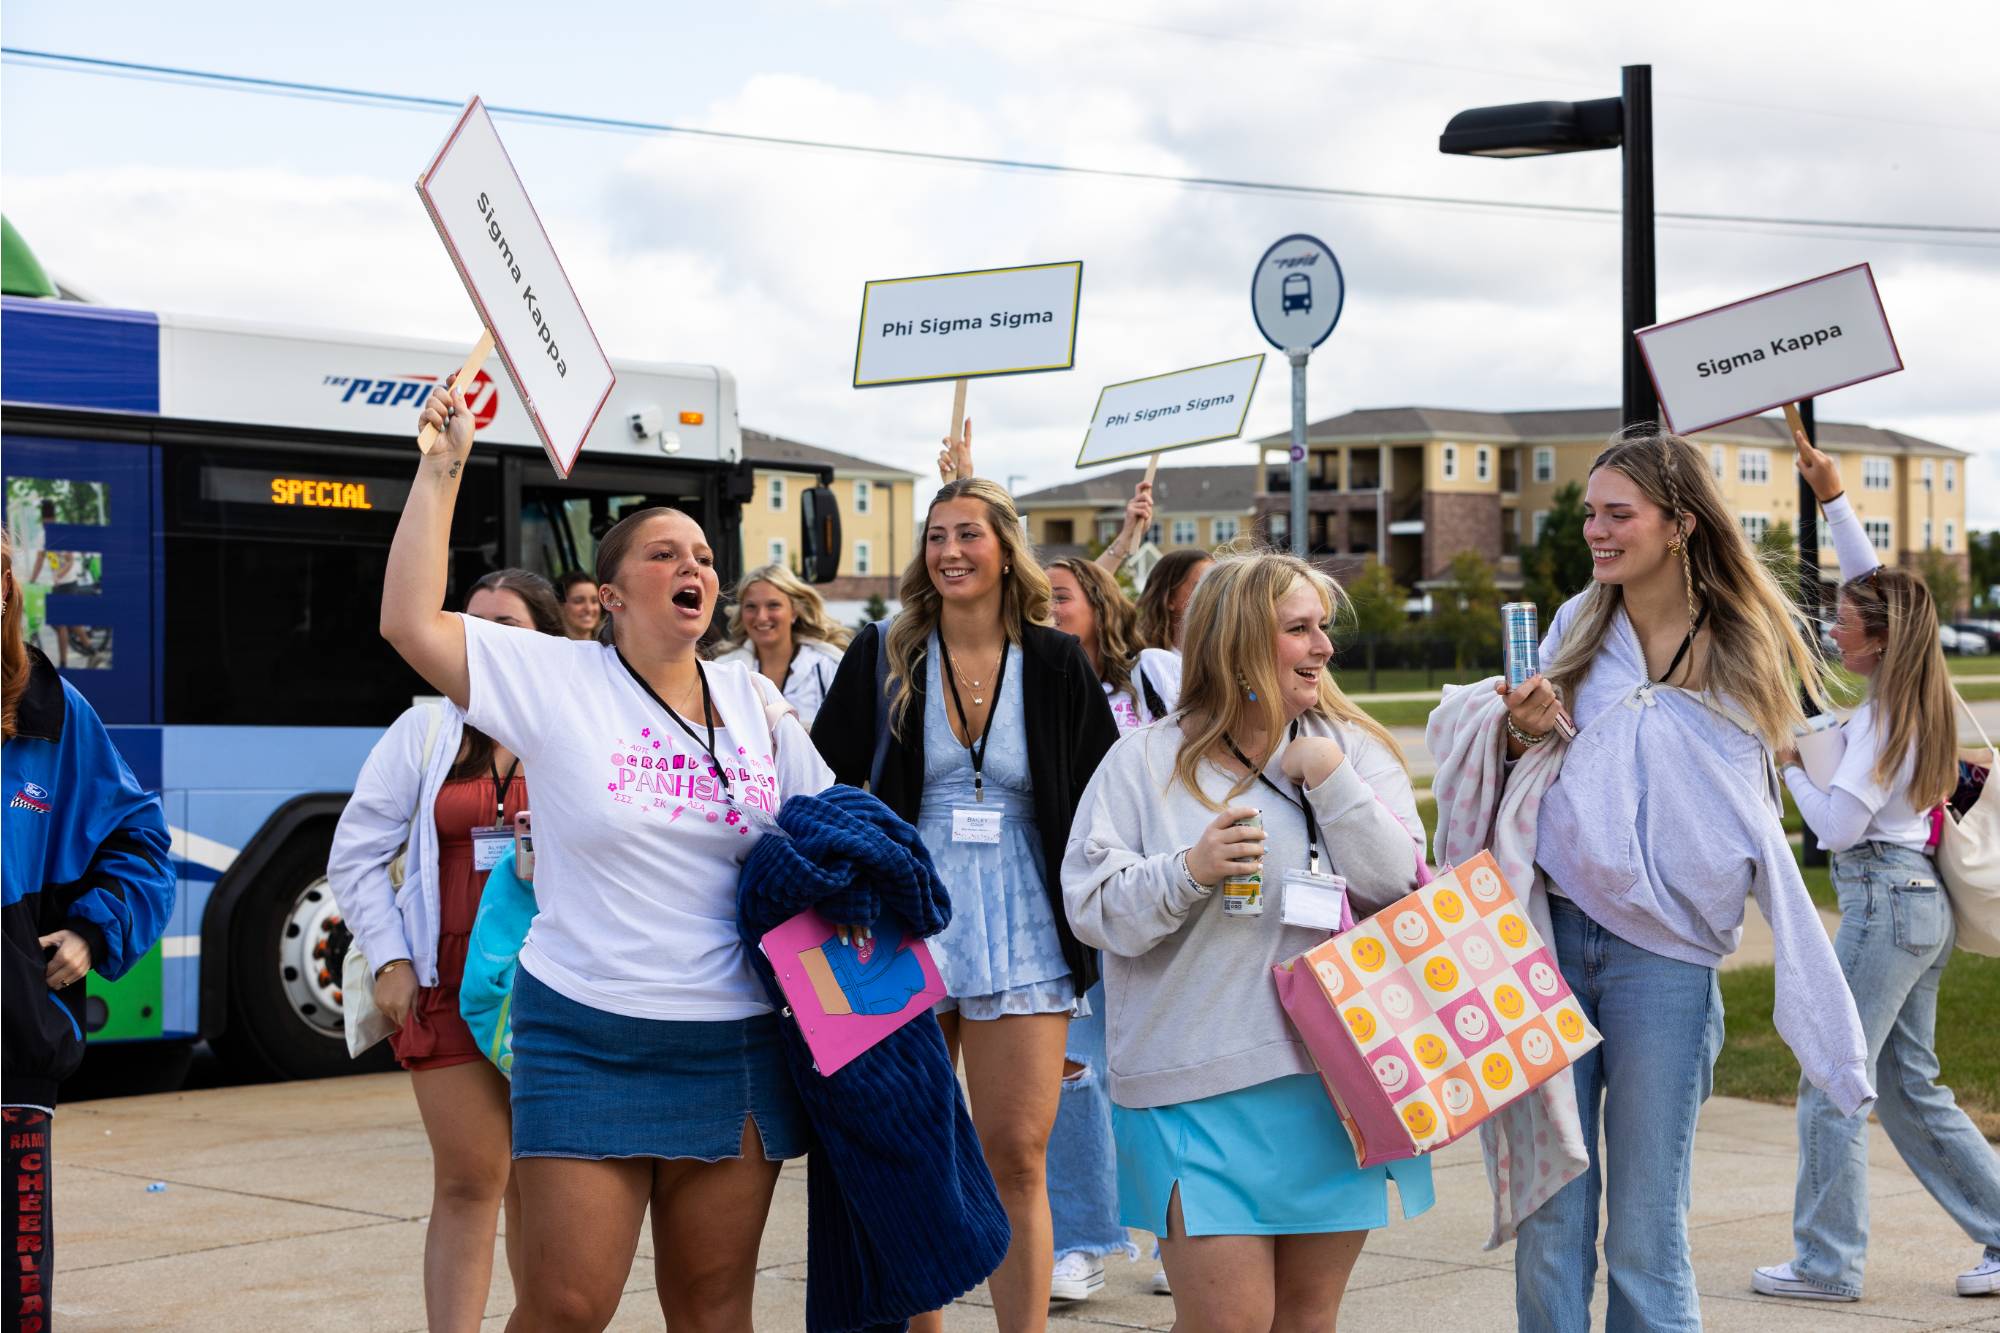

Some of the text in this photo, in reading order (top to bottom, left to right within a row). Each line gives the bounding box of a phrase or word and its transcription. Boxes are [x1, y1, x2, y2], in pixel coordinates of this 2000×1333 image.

[477, 192, 567, 378] Sigma Kappa
[882, 311, 1053, 337] Phi Sigma Sigma
[1696, 324, 1843, 378] Sigma Kappa
[342, 378, 436, 408] rapi
[1105, 393, 1234, 427] Phi Sigma Sigma
[271, 478, 372, 509] SPECIAL
[627, 754, 699, 771] GRAND
